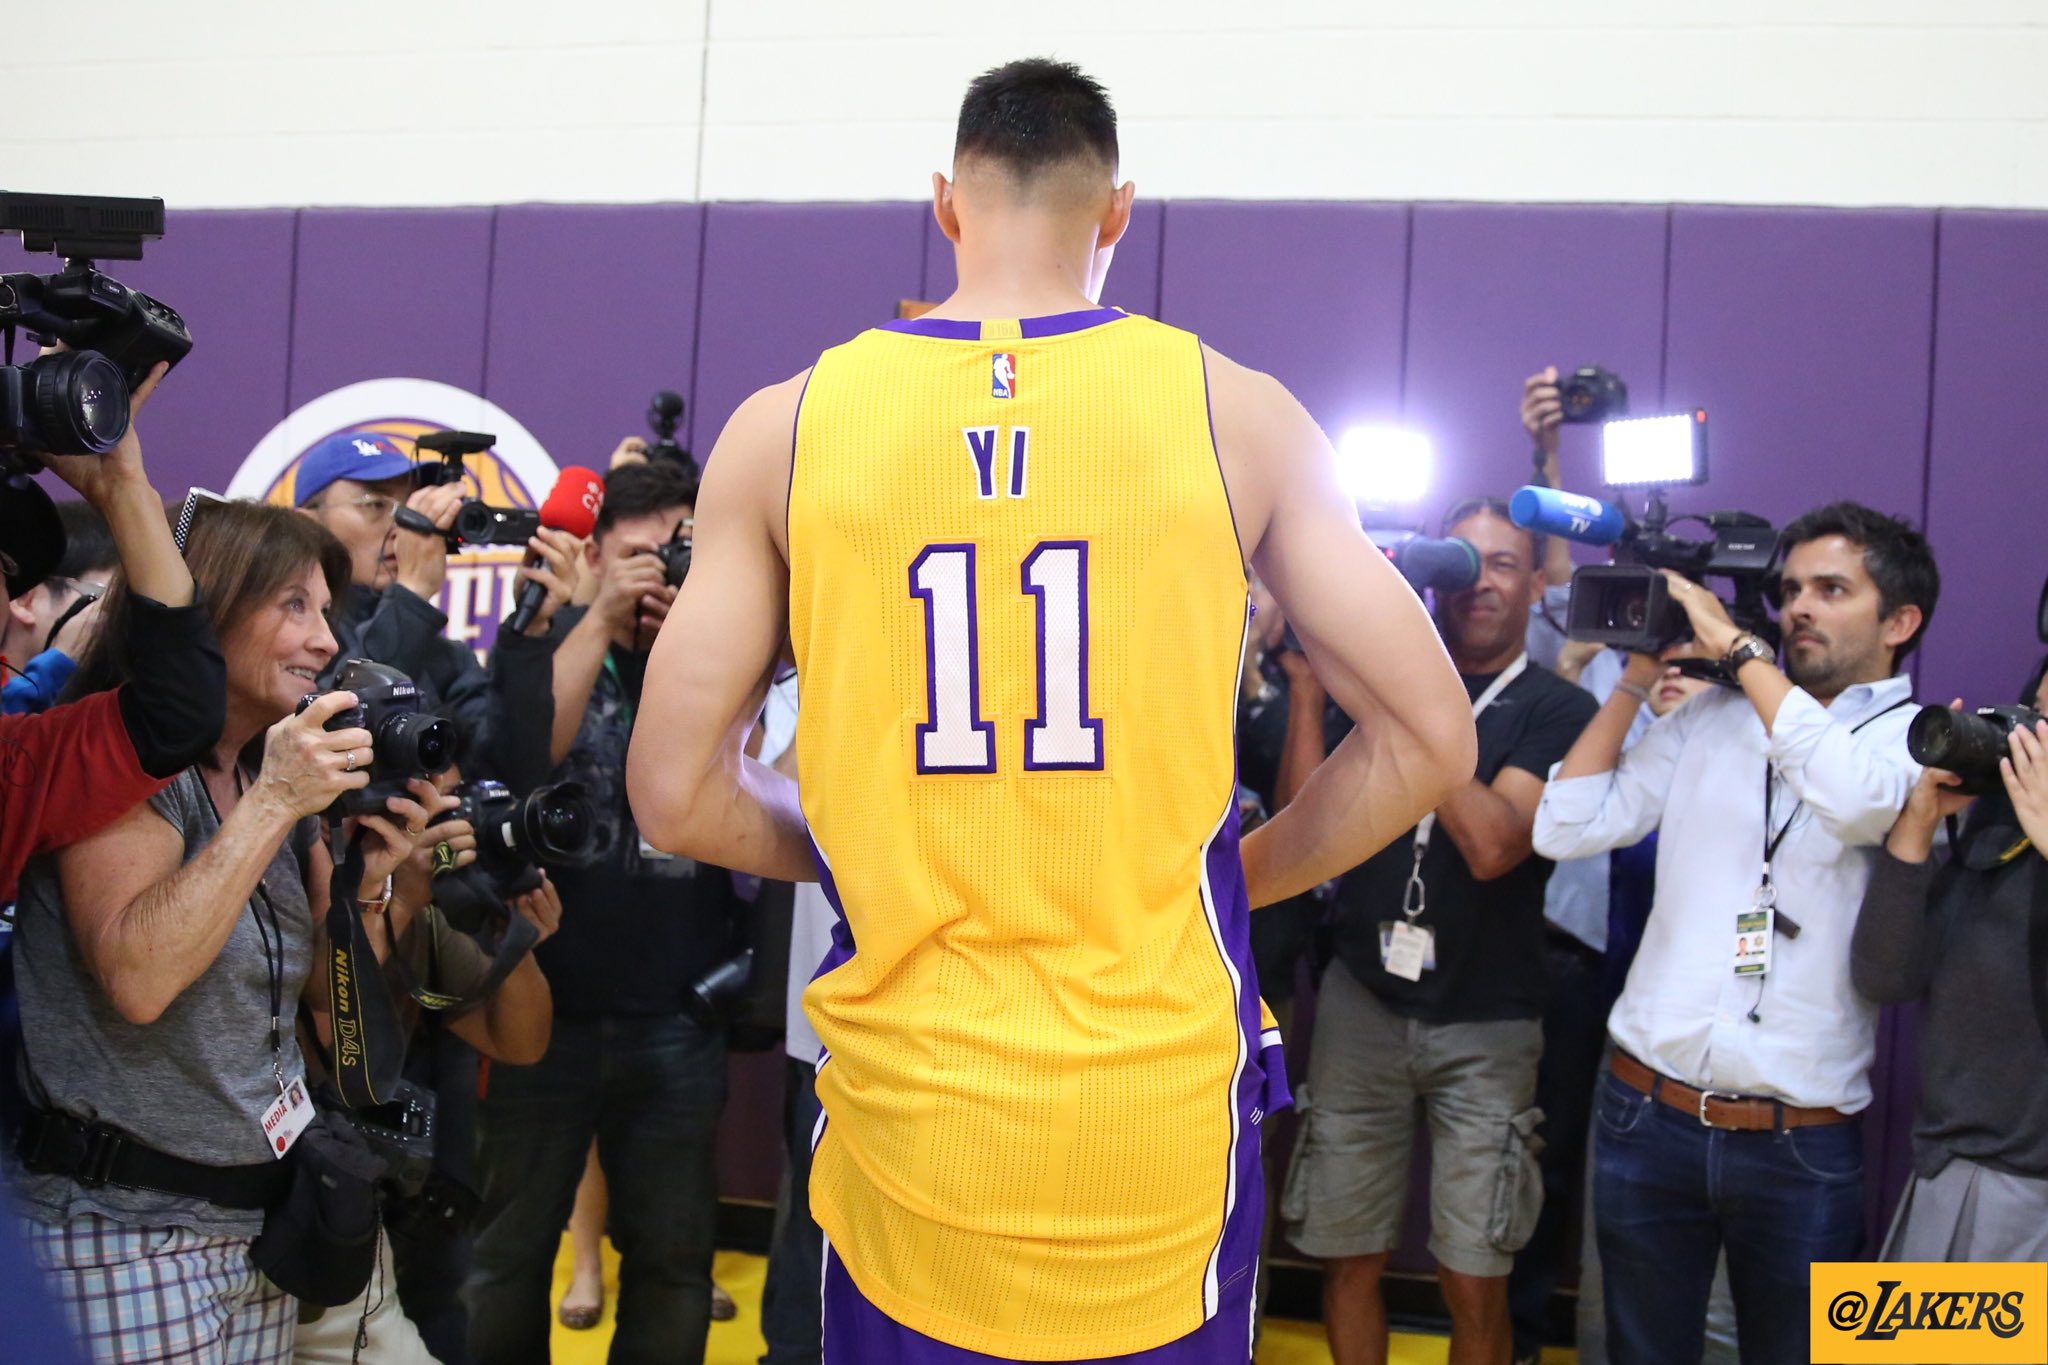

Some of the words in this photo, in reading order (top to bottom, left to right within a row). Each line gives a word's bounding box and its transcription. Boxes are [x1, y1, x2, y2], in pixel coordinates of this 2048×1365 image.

[993, 388, 1009, 397] NBA
[962, 425, 1030, 499] YI
[908, 540, 1105, 776] 11
[392, 686, 416, 697] Nikon
[334, 948, 351, 1013] Nikon
[264, 1103, 288, 1134] MEDIA
